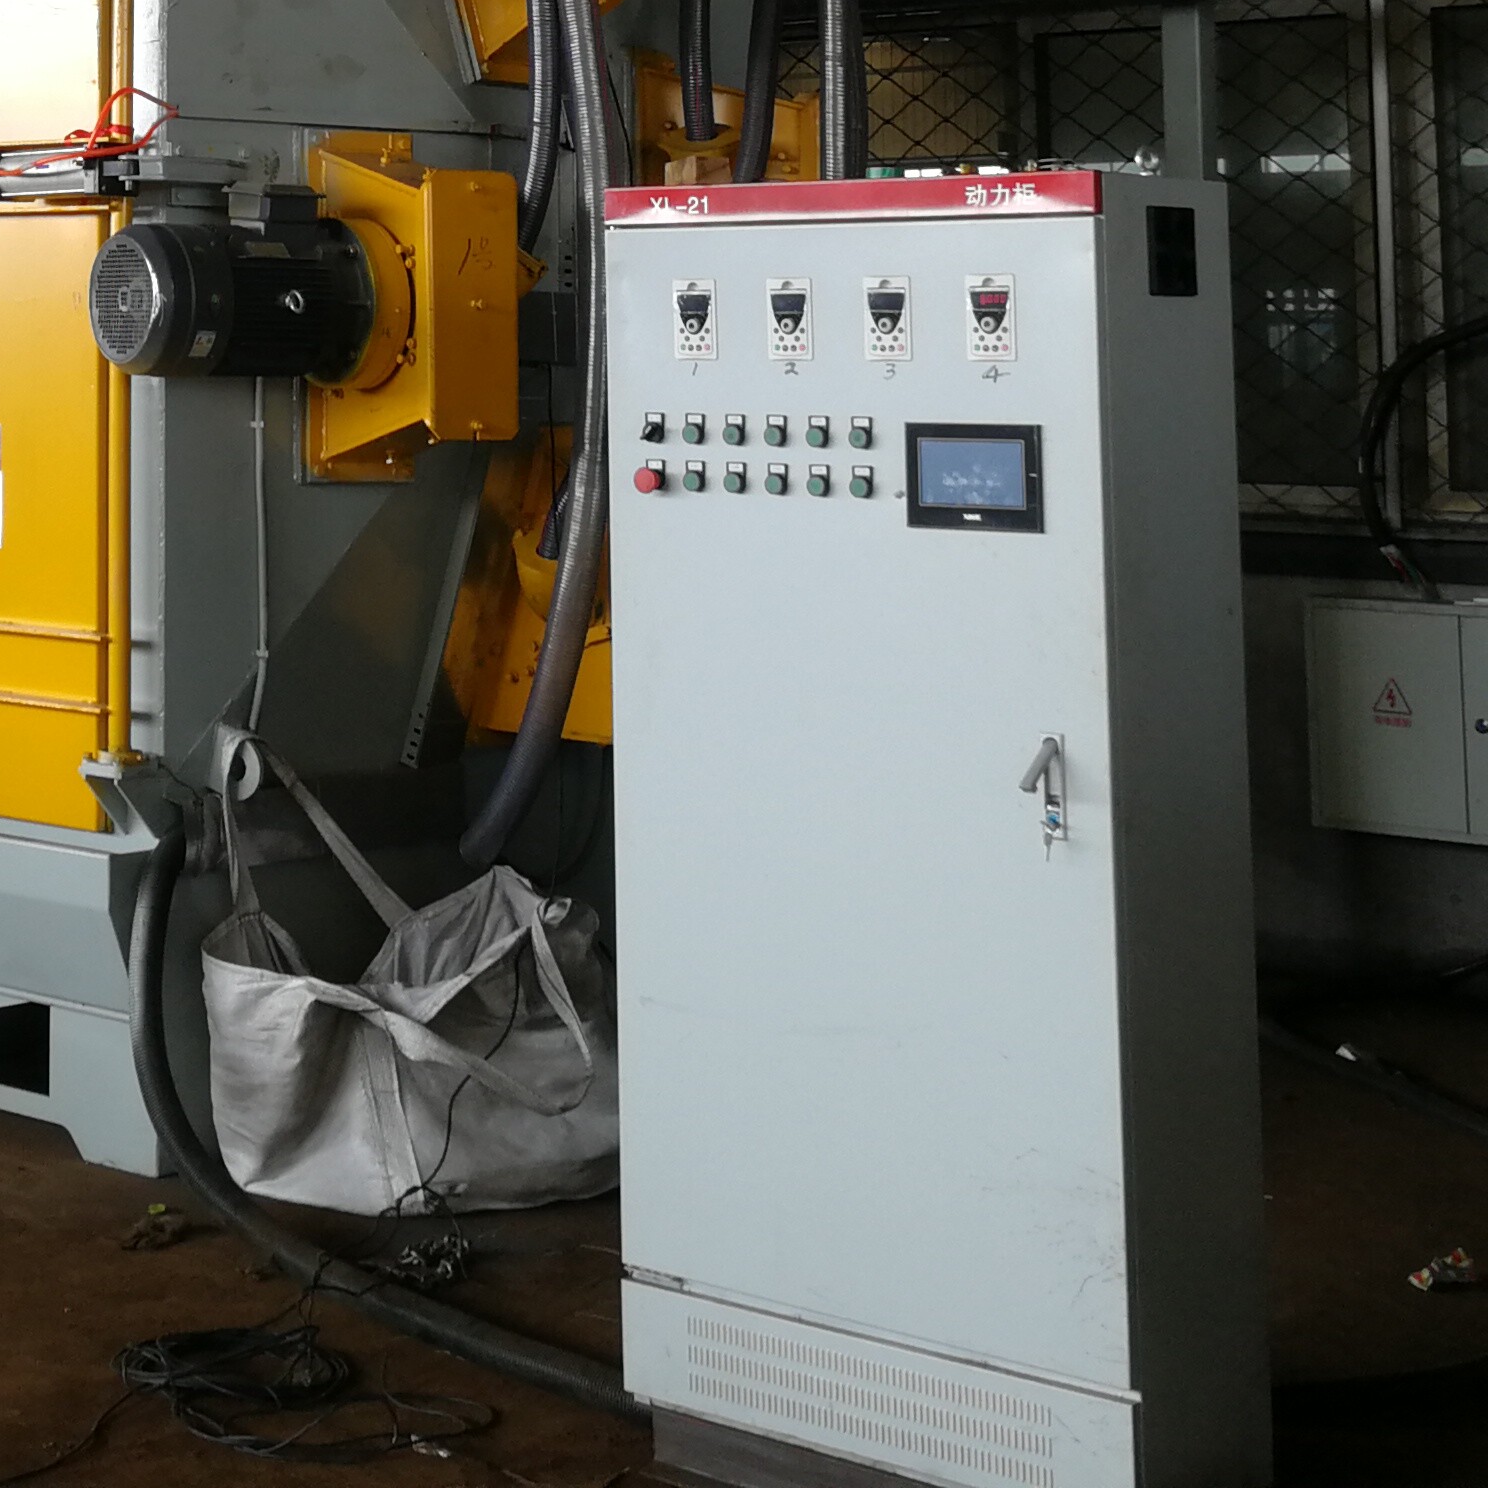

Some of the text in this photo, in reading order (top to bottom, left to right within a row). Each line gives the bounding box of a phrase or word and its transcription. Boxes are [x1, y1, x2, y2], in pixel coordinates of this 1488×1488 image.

[692, 362, 698, 376] 1
[784, 362, 798, 375] 2
[883, 363, 896, 380] 3
[982, 365, 1011, 383] 4
